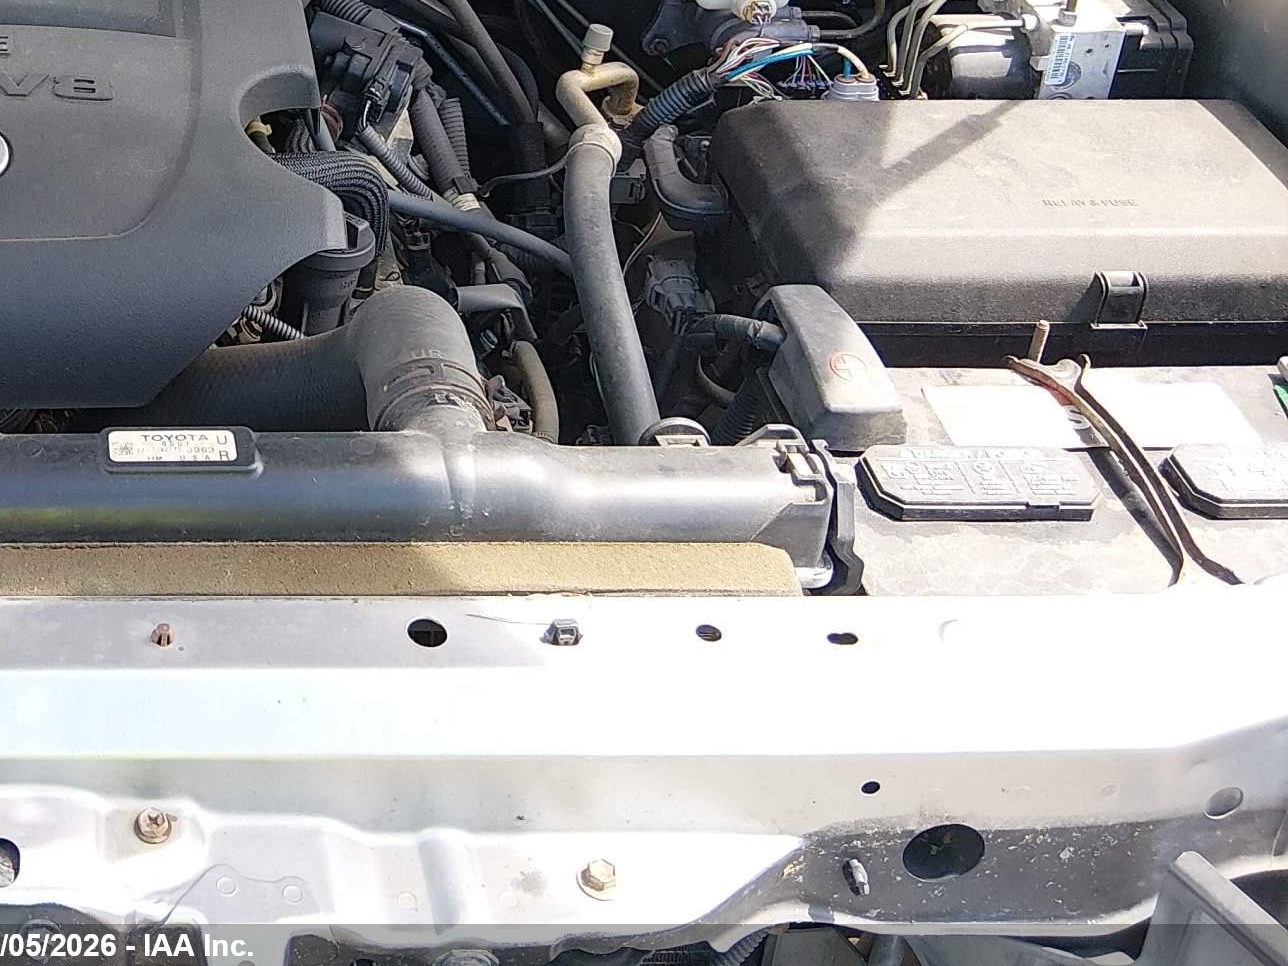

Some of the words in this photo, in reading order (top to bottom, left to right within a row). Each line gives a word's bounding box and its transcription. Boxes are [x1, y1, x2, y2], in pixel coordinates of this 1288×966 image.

[140, 434, 209, 442] TOYOTA
[216, 435, 228, 445] U
[218, 450, 230, 460] R
